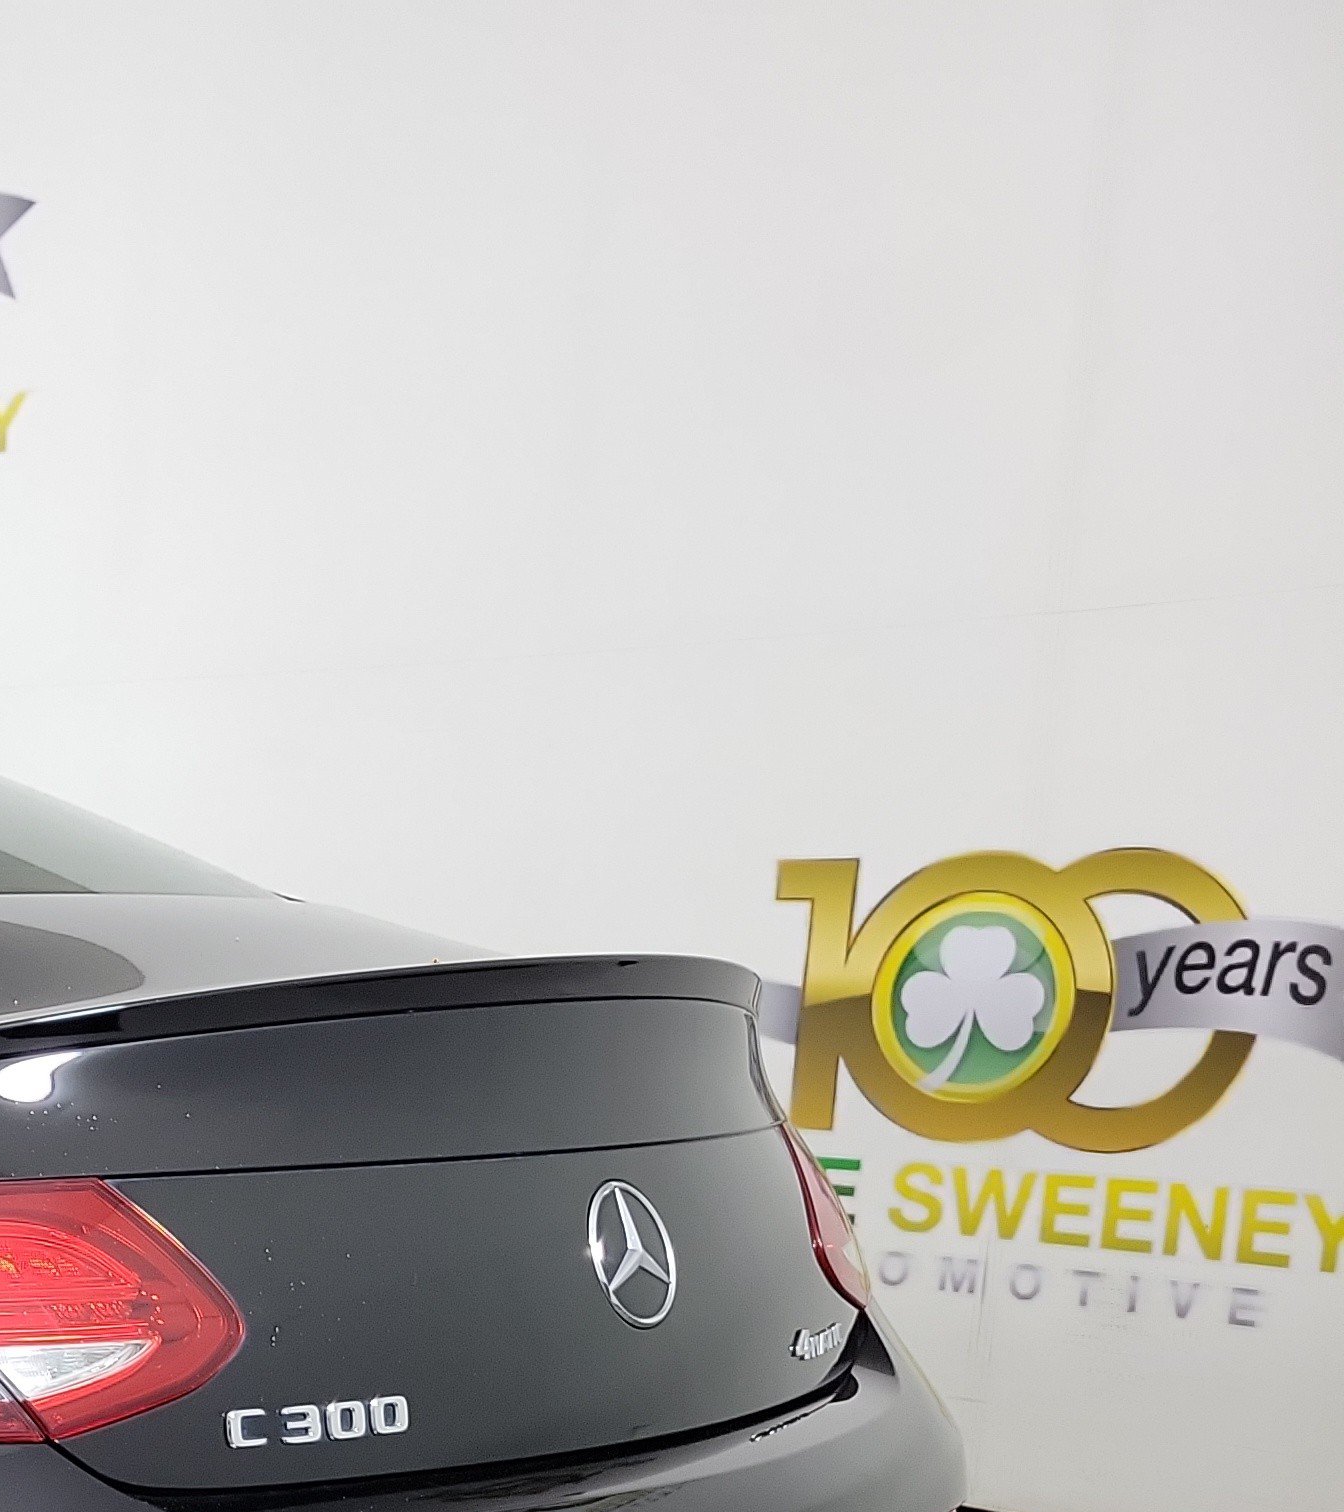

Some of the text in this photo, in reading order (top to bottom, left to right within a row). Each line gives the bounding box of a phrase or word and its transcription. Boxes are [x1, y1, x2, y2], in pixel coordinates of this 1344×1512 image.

[776, 846, 1333, 1154] 100 years
[887, 1161, 1344, 1274] SWEENEY
[877, 1250, 1265, 1329] OMOTIVE
[226, 1395, 410, 1449] C 300
